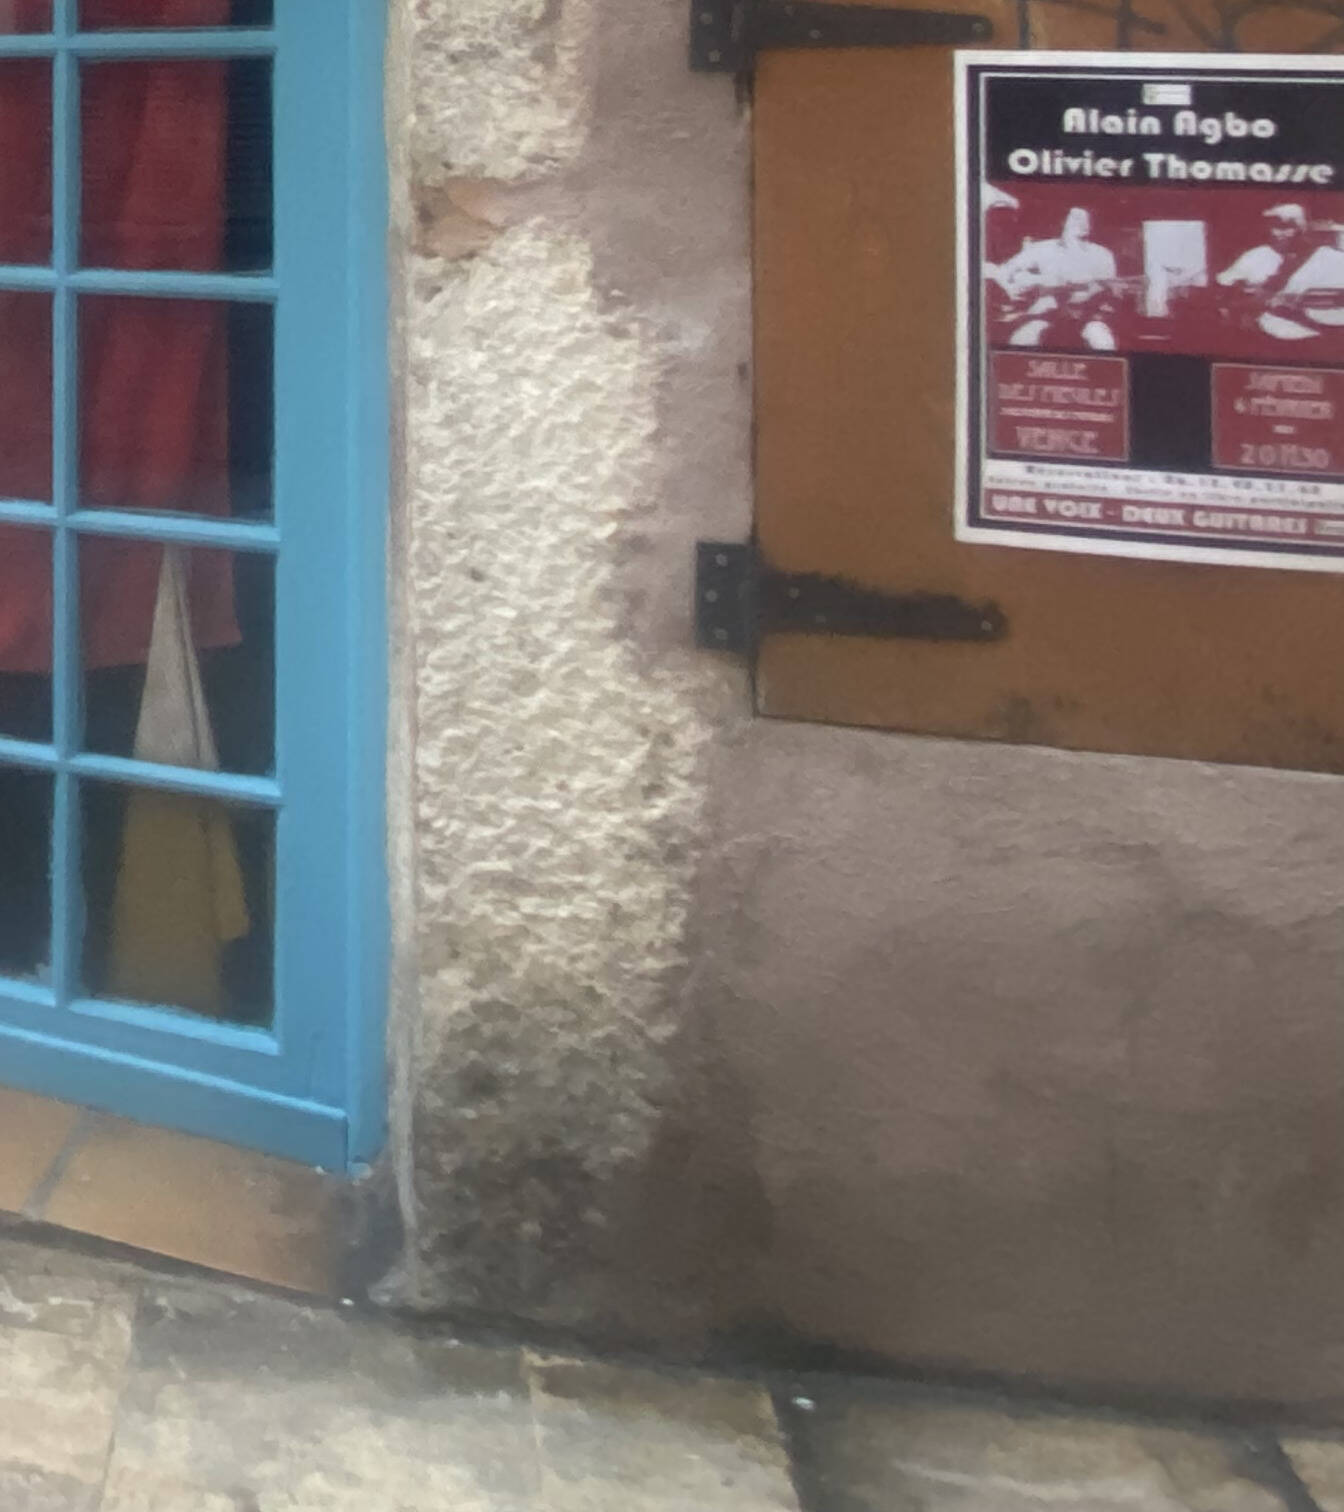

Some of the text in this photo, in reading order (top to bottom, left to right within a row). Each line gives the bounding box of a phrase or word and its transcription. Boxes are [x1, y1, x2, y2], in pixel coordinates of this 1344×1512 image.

[1063, 107, 1278, 145] Alain Agbo
[1008, 148, 1336, 184] Olivier Thomasse
[1043, 499, 1103, 519] VOIX
